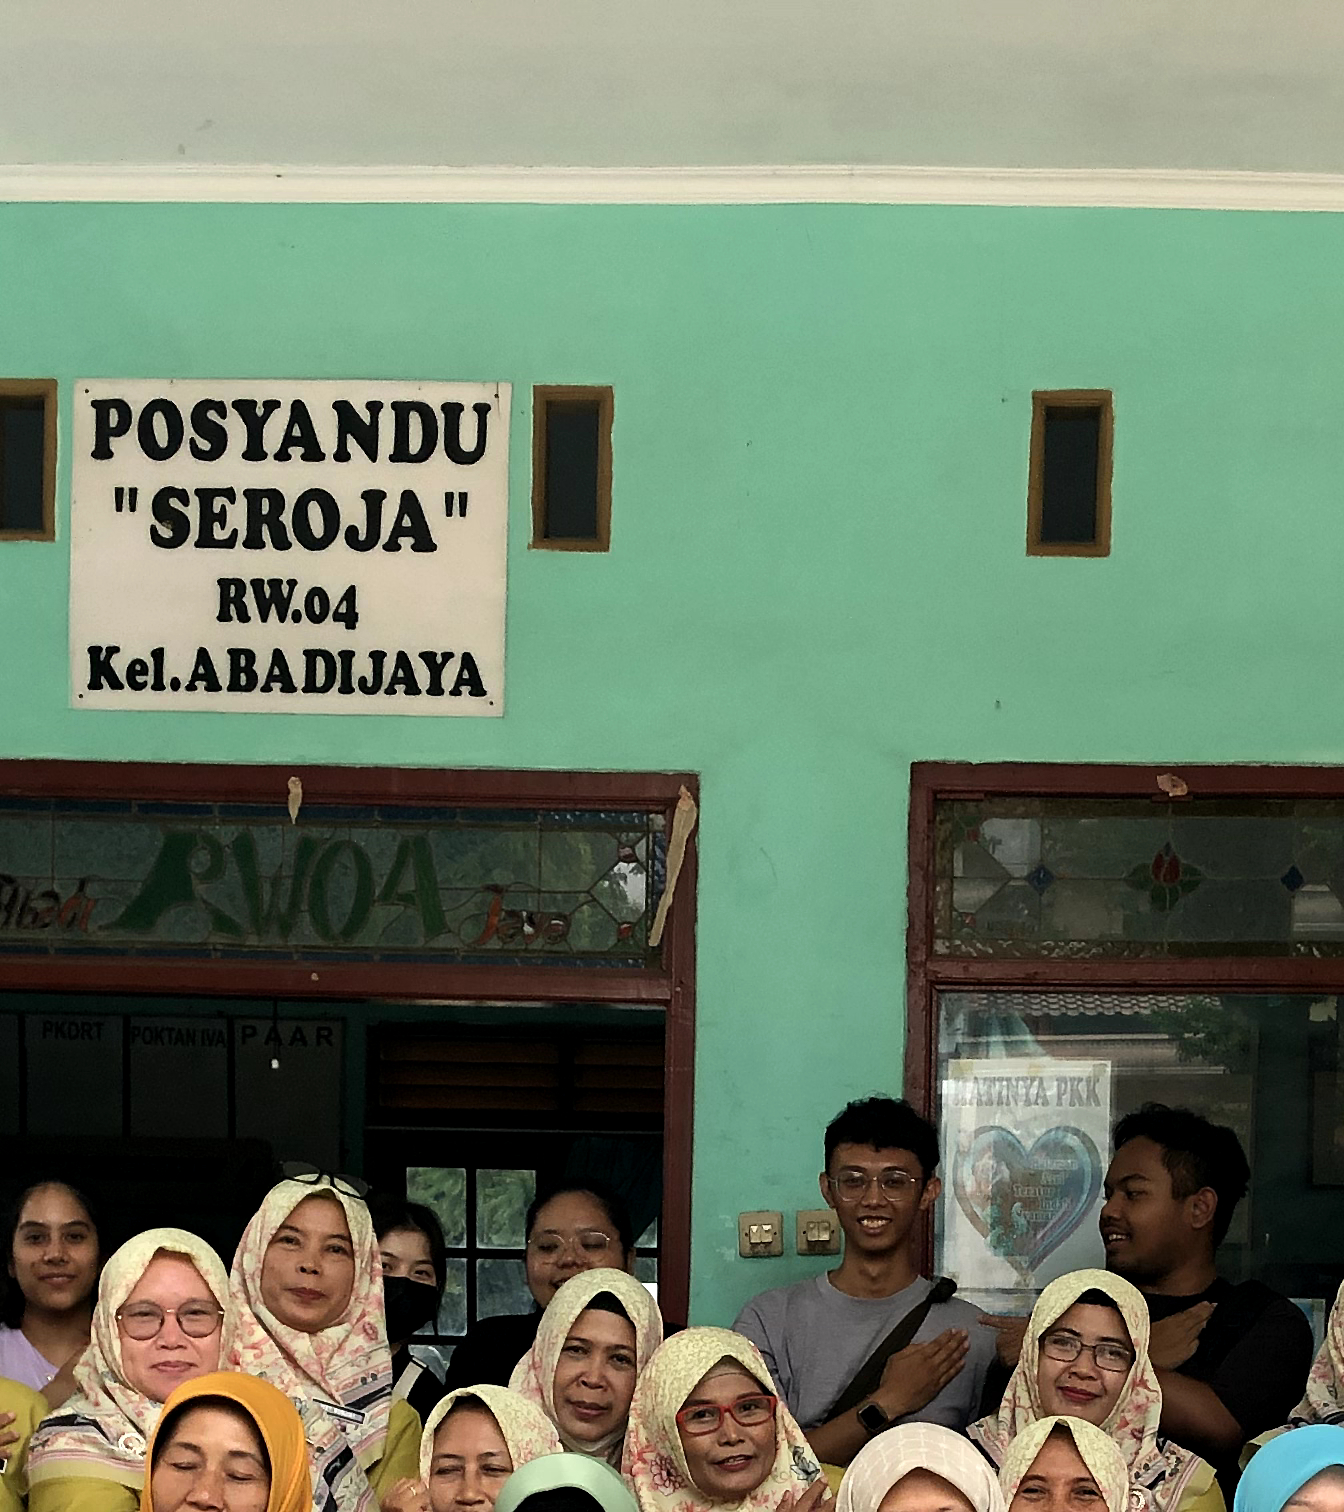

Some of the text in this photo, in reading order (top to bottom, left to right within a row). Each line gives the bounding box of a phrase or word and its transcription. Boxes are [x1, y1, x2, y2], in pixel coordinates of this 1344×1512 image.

[90, 398, 491, 465] POSYANDU
[114, 486, 468, 552] "SEROJA"
[217, 578, 358, 630] RW.04
[131, 1026, 198, 1048] POKTAN
[1055, 1076, 1102, 1108] PKK
